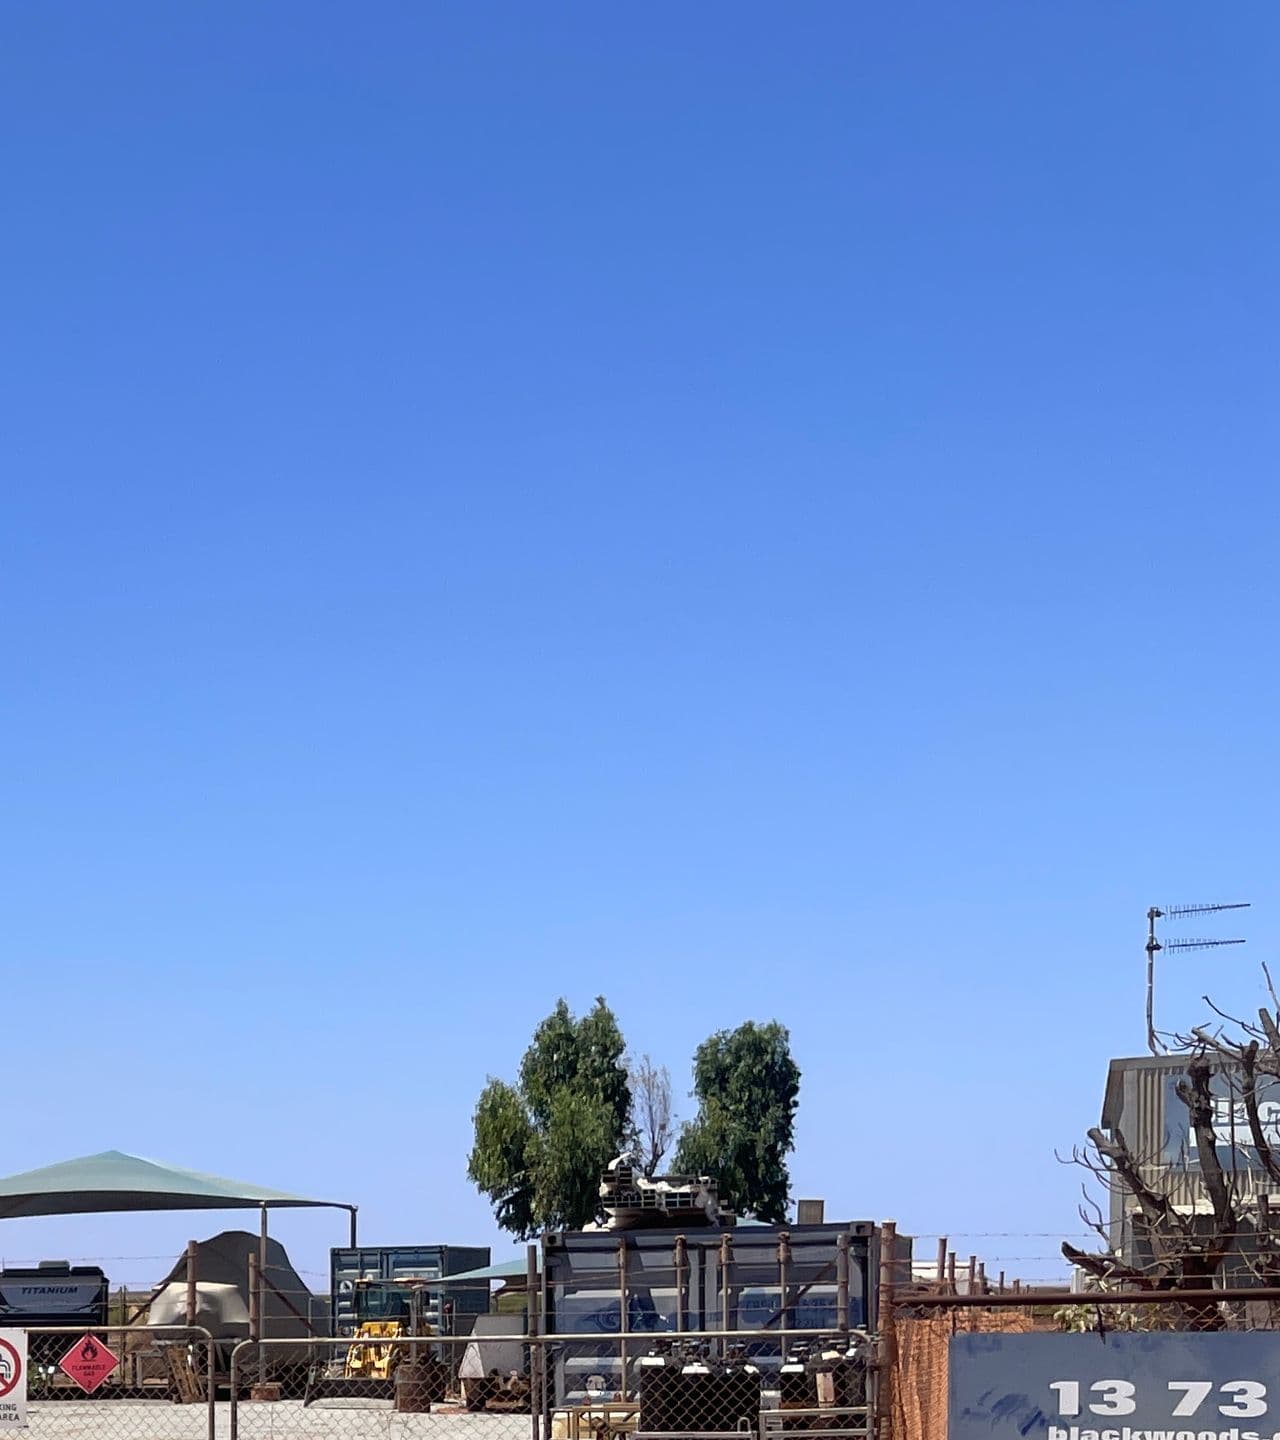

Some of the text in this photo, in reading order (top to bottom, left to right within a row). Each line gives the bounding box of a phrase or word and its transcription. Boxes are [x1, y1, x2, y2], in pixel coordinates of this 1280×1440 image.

[22, 1287, 78, 1295] TITANIUM
[1049, 1380, 1268, 1418] 13 73
